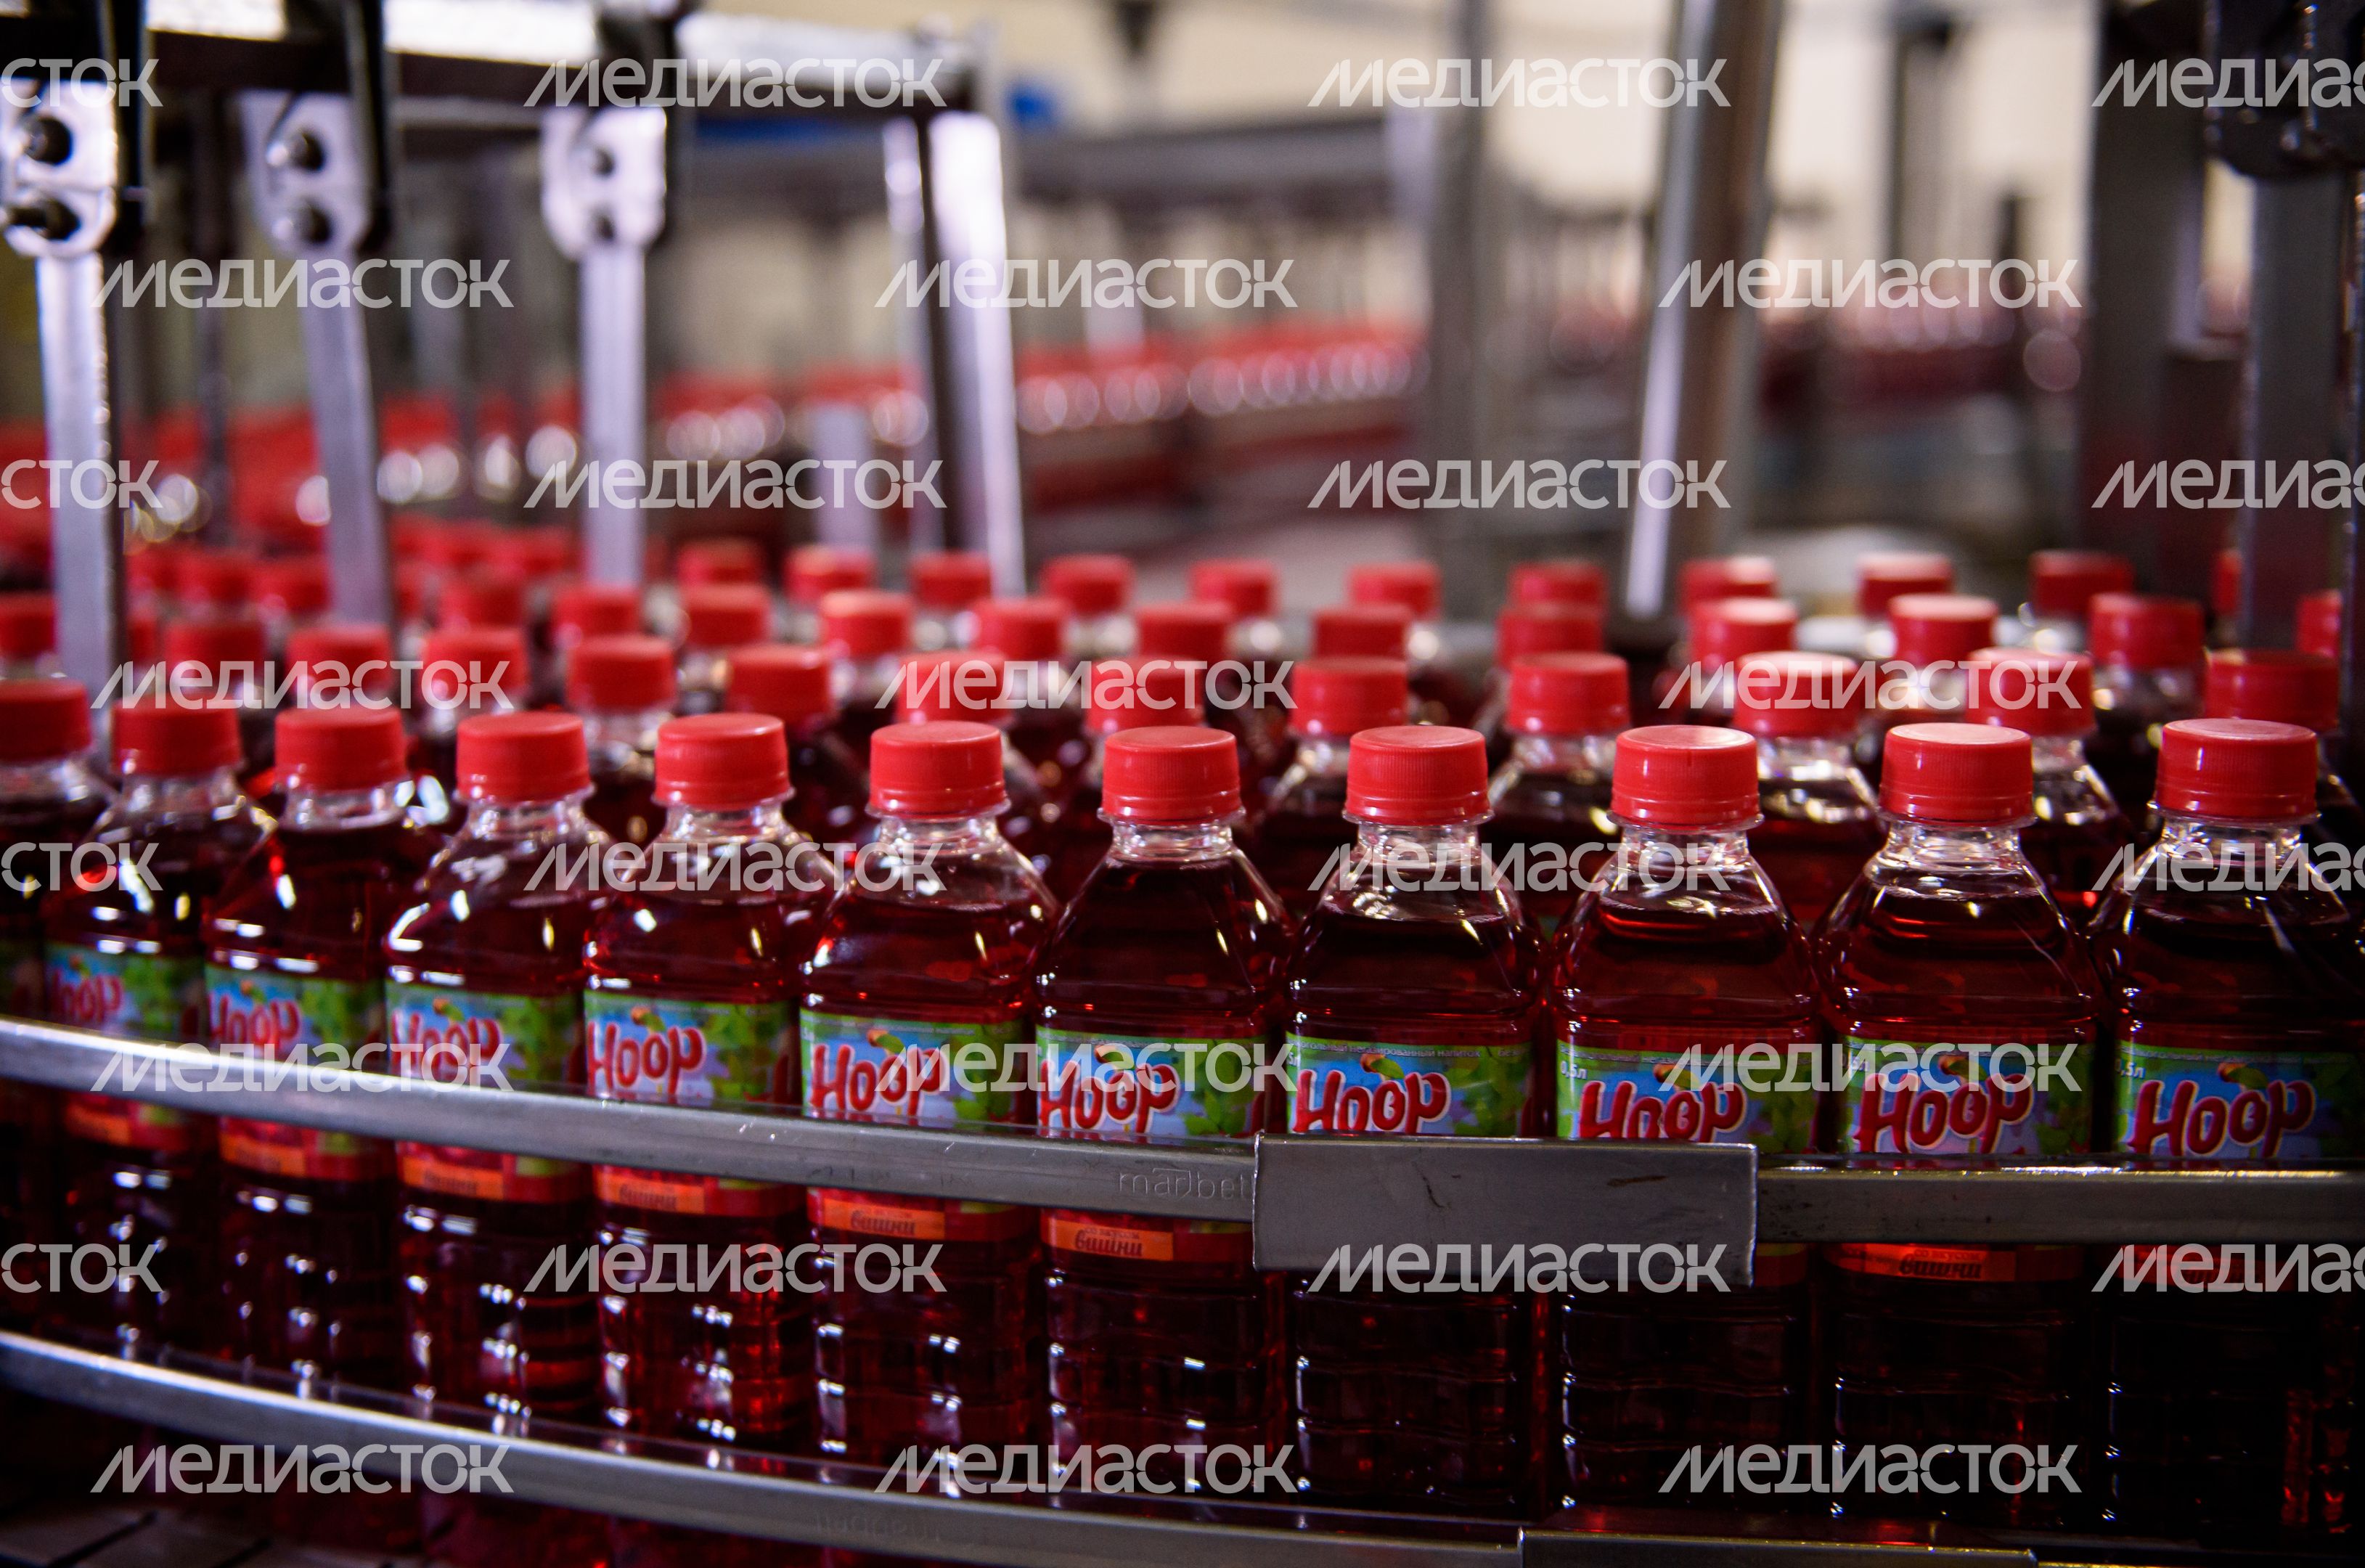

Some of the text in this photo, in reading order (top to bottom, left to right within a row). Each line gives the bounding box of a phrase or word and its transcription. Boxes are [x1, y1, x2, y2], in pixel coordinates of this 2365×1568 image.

[587, 1021, 706, 1096] Hoop
[809, 1042, 948, 1117] Hoop
[1560, 1060, 1588, 1080] 0,5л
[1038, 1059, 1181, 1134] Hoop
[1291, 1069, 1453, 1133] Hoop
[1578, 1080, 1748, 1143] Hoop
[1853, 1071, 2034, 1154] Hoop
[2125, 1078, 2317, 1158] Hoop
[1075, 1228, 1143, 1257] вишни
[1898, 1253, 1982, 1279] вишни
